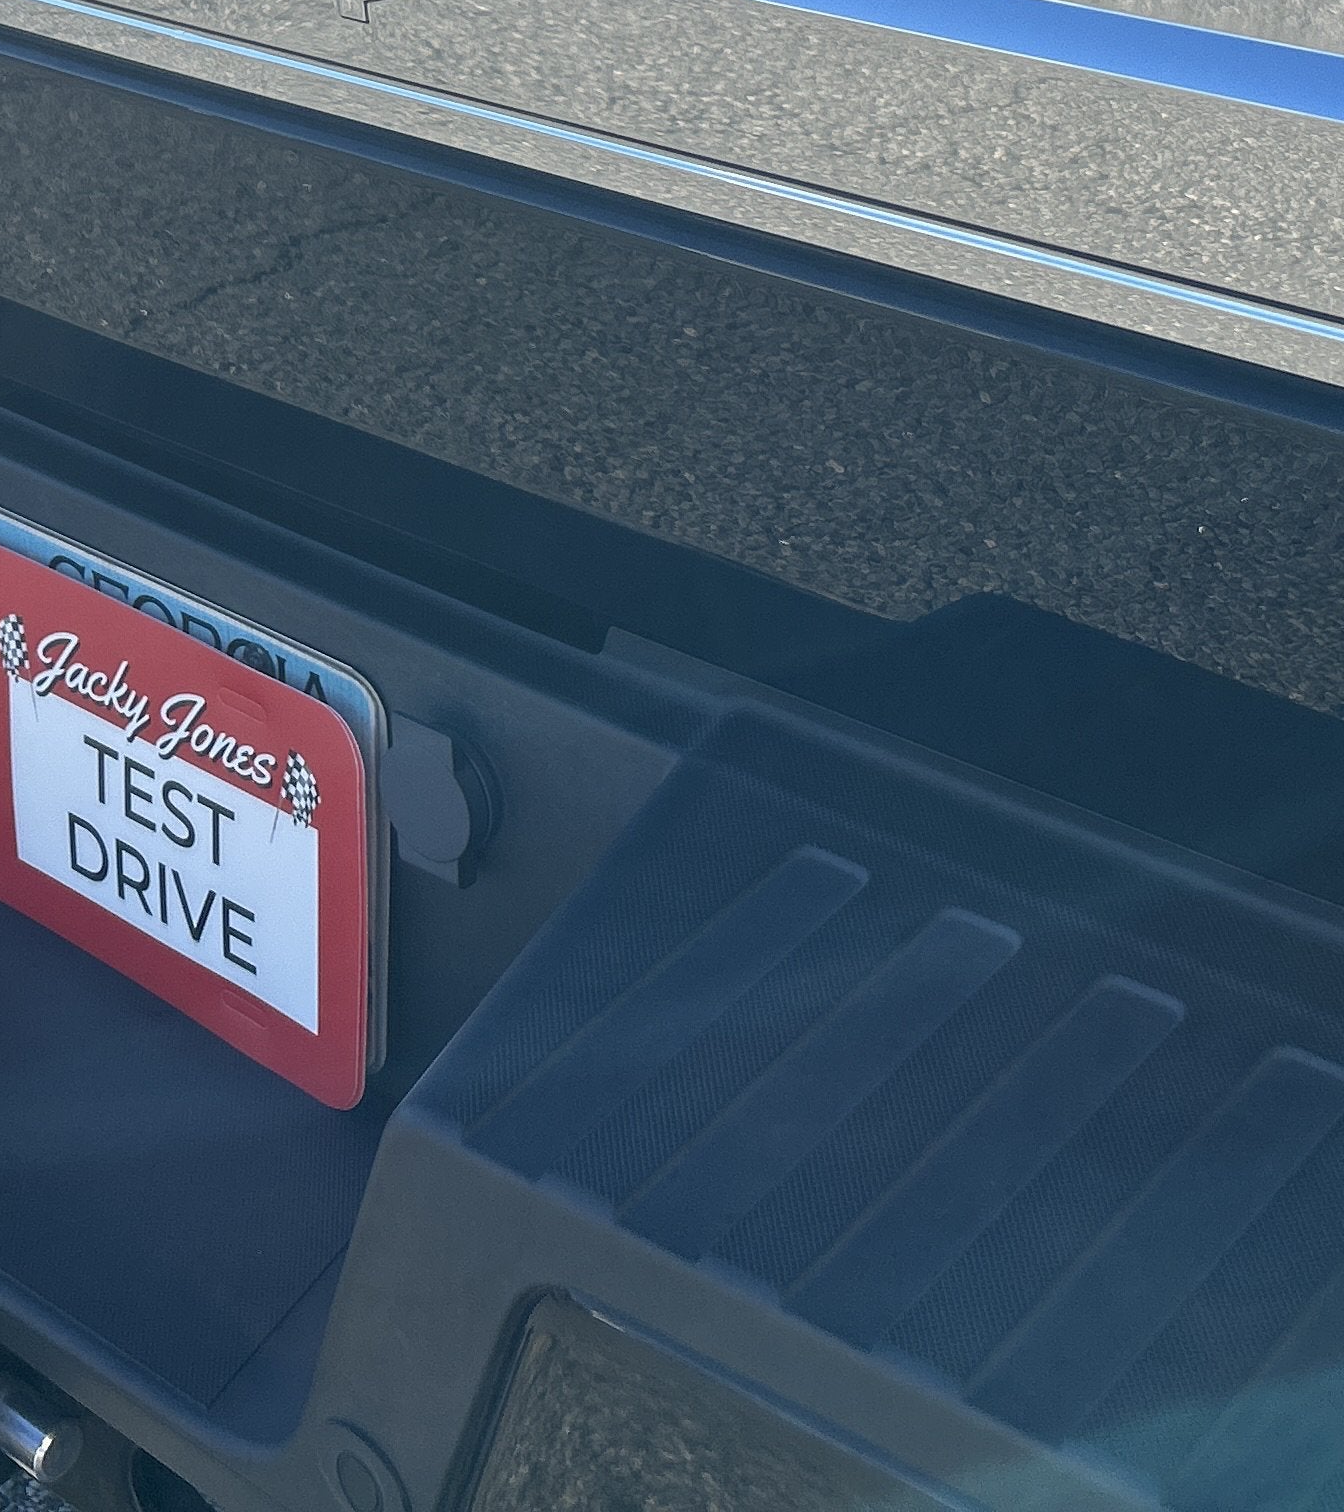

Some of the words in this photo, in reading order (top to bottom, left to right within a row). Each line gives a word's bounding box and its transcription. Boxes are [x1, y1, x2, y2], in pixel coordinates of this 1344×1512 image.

[34, 631, 150, 744] Jacky
[156, 691, 278, 790] Jones
[84, 734, 236, 866] TEST
[68, 811, 258, 976] DRIVE
